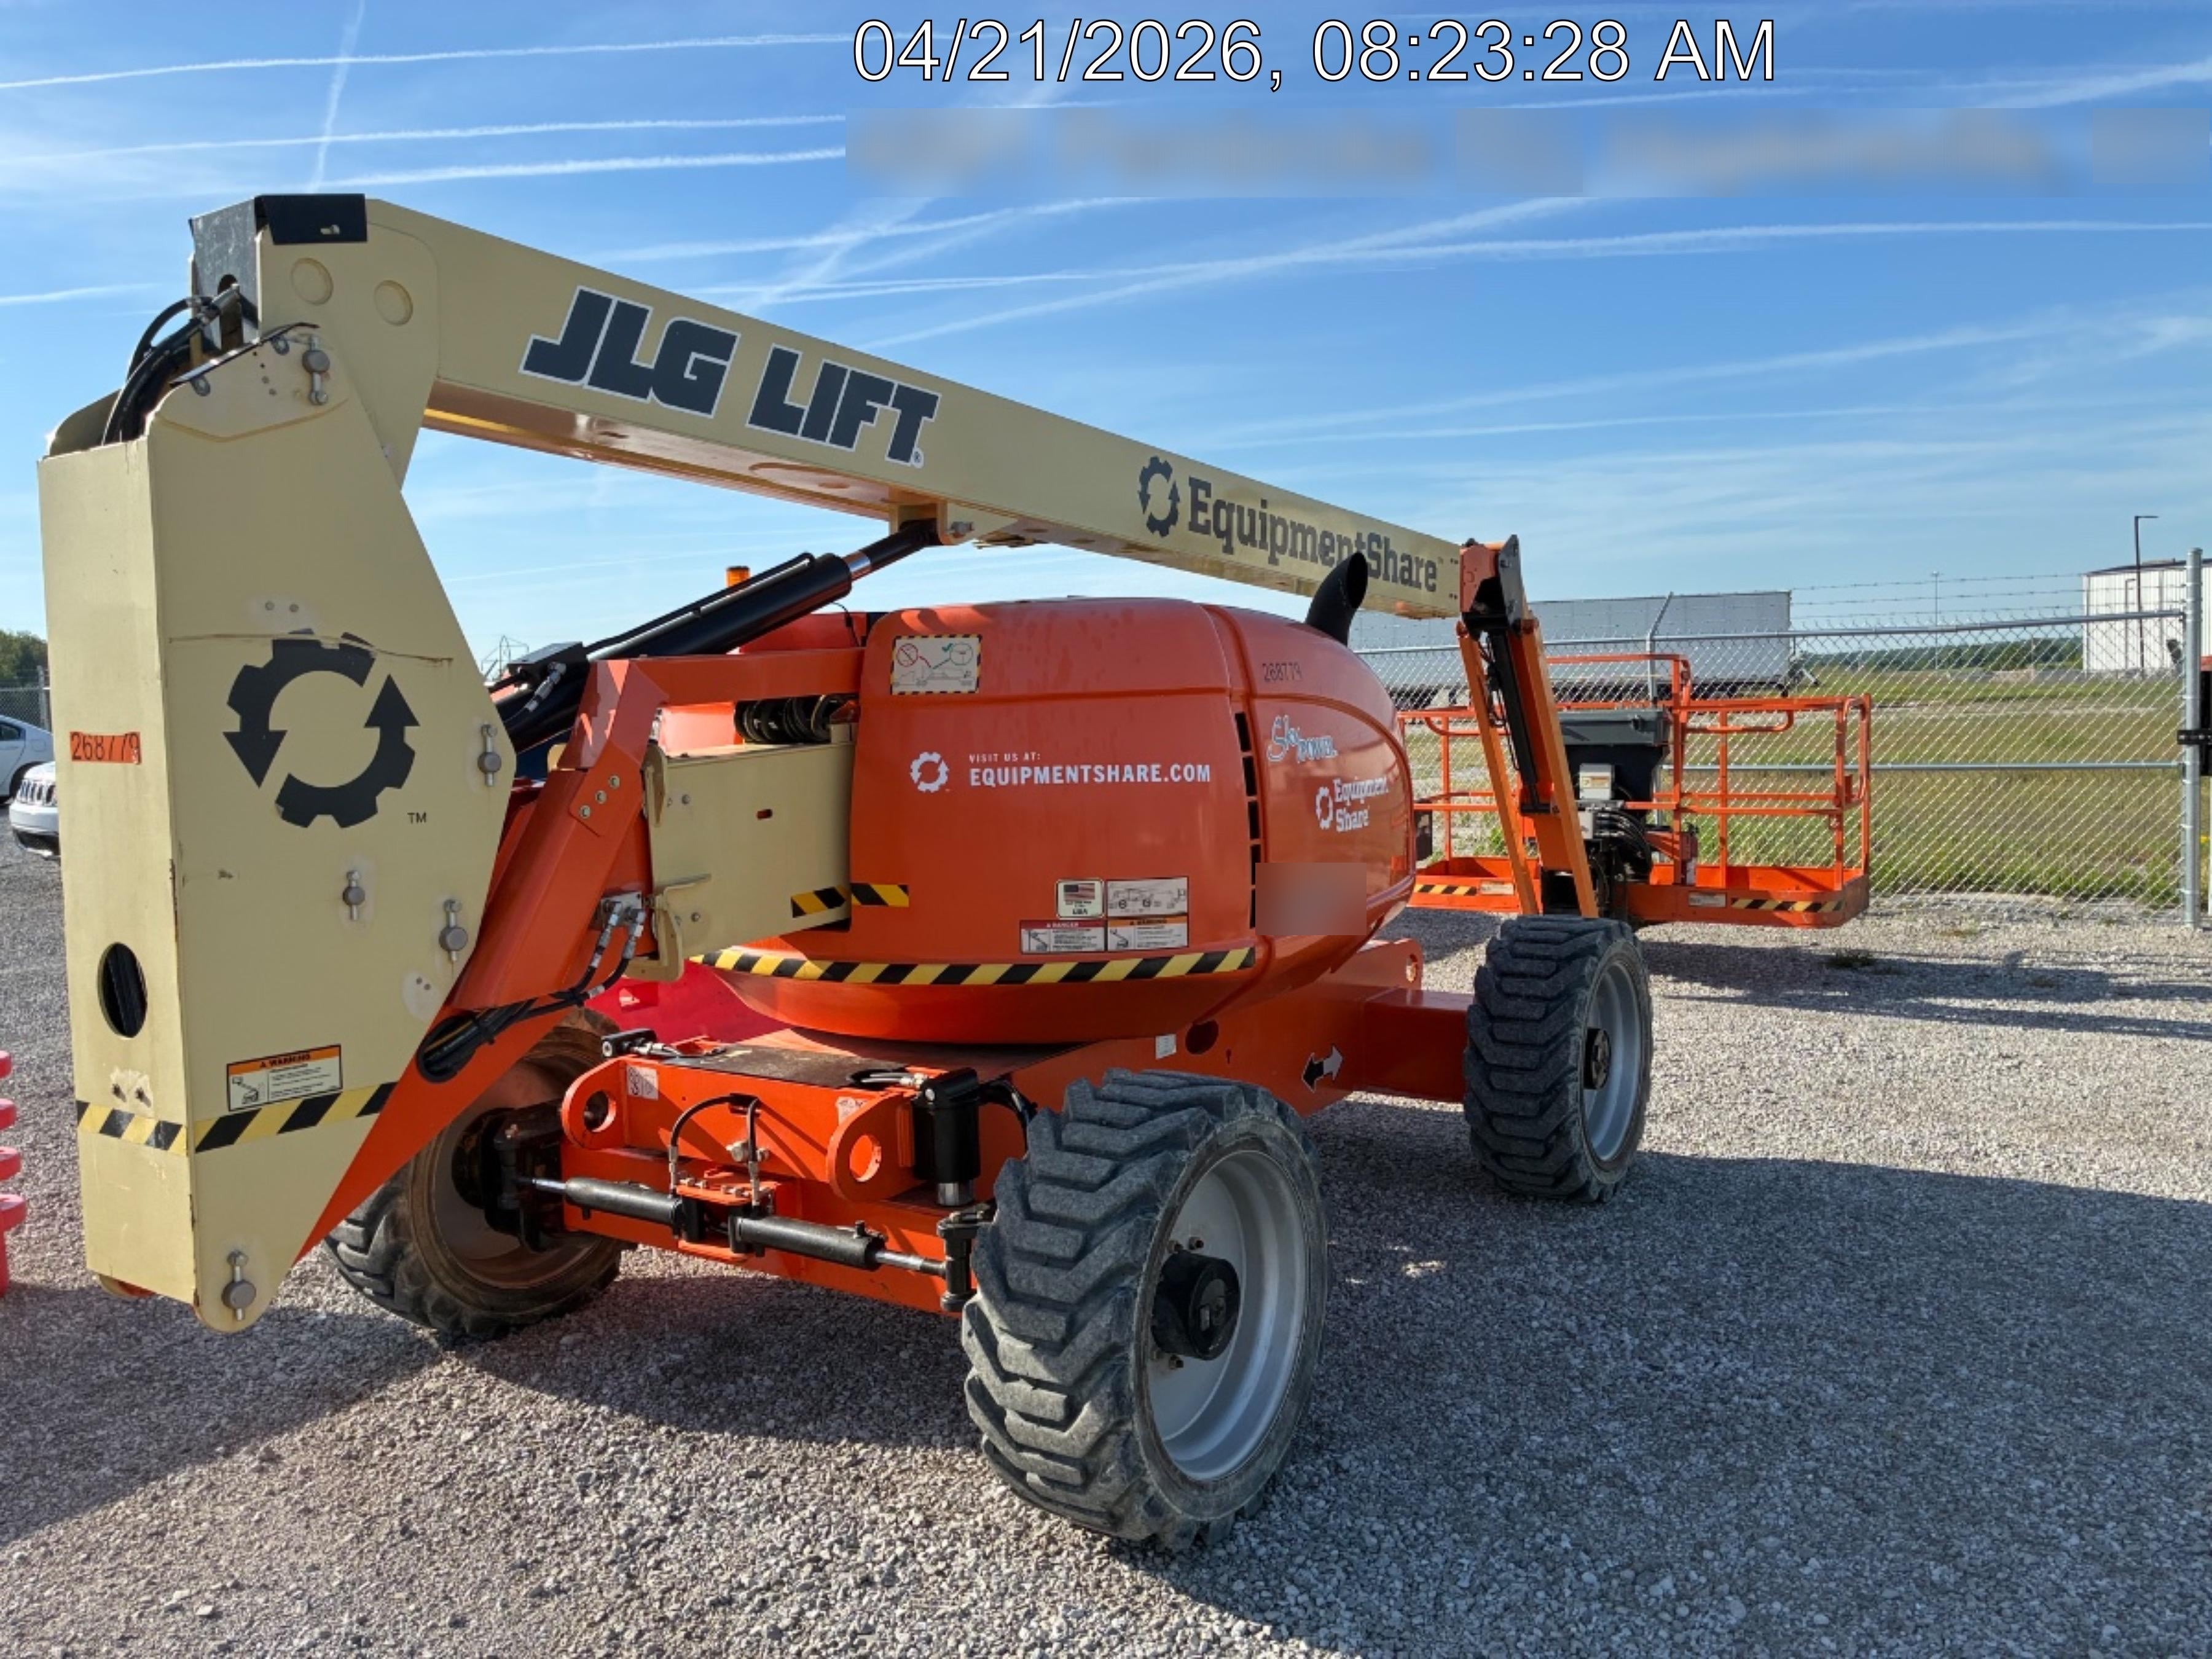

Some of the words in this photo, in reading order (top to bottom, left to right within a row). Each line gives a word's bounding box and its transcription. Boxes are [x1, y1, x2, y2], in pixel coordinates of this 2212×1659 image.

[519, 285, 741, 418] JLG
[1188, 476, 1437, 593] EquipmentShare
[968, 753, 1000, 763] VISIT
[1004, 753, 1019, 762] US
[1024, 751, 1041, 762] AT:
[970, 764, 1210, 787] EQUIPMENTSHARE.COM
[407, 811, 427, 824] TM
